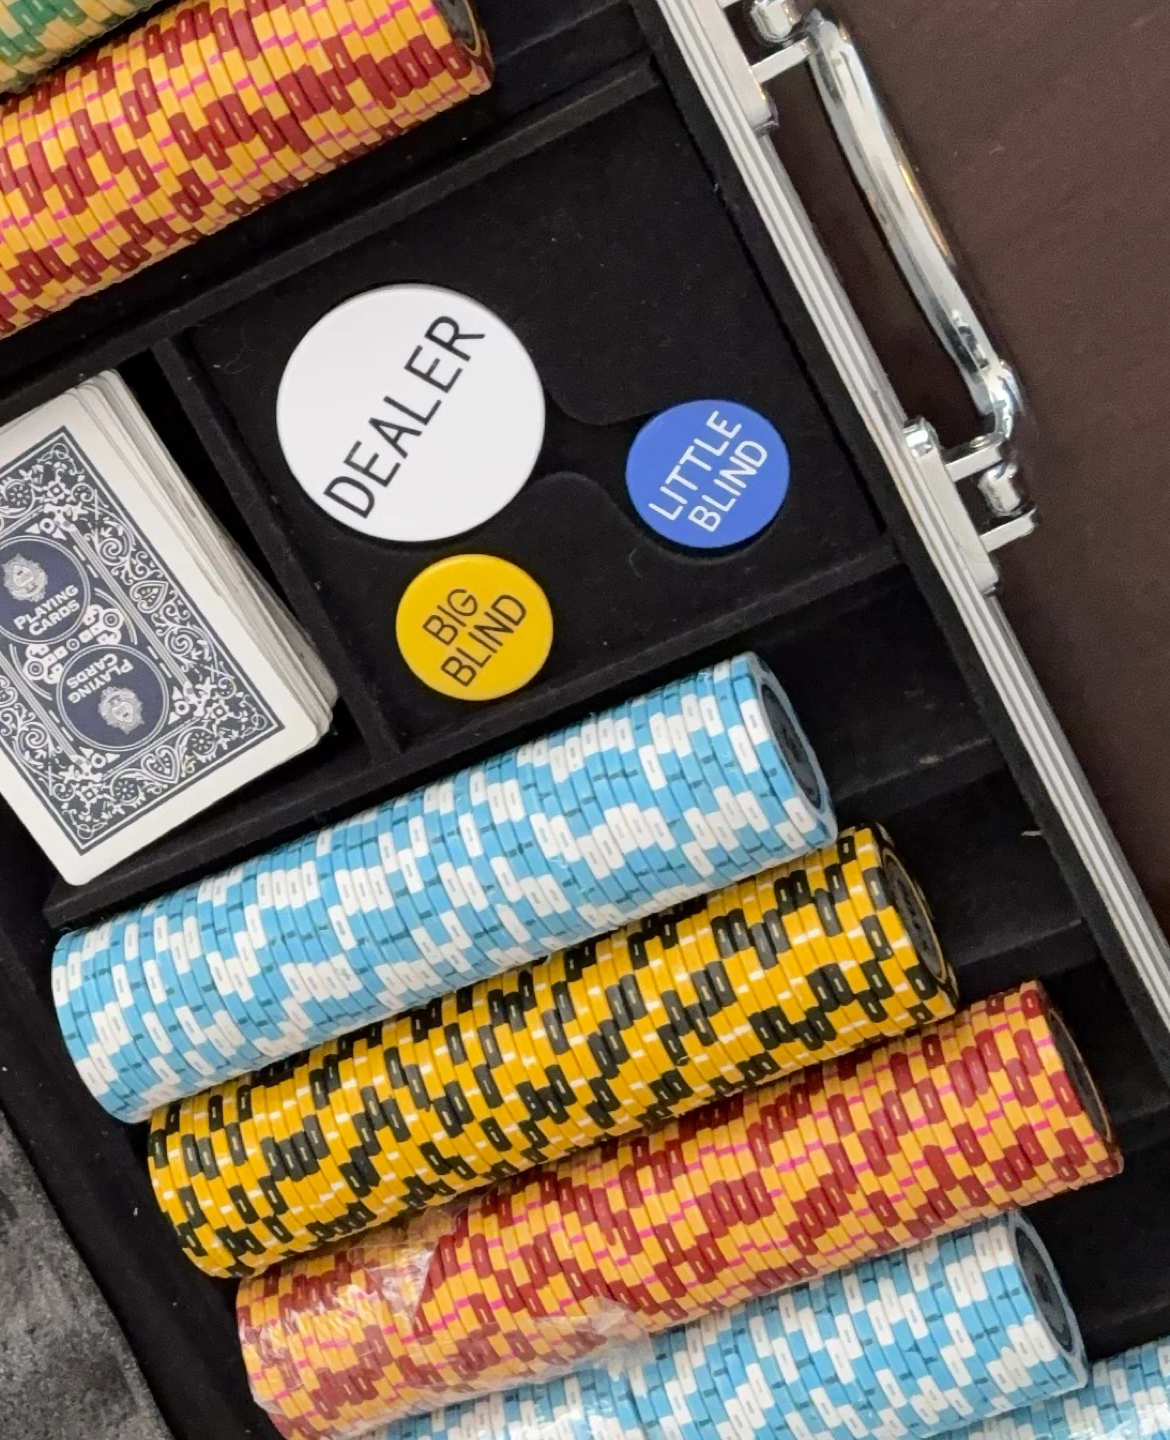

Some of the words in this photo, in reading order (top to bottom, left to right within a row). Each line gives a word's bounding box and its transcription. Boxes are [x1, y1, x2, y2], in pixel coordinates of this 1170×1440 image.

[324, 316, 486, 519] DEALER
[648, 410, 742, 521] LITTLE
[687, 439, 768, 532] BLIND
[13, 584, 79, 631] PLAYING
[29, 599, 80, 636] CARDS
[422, 588, 479, 646] BIG
[440, 594, 527, 687] BLIND
[66, 653, 118, 690] CARDS
[67, 659, 134, 704] PLAYING
